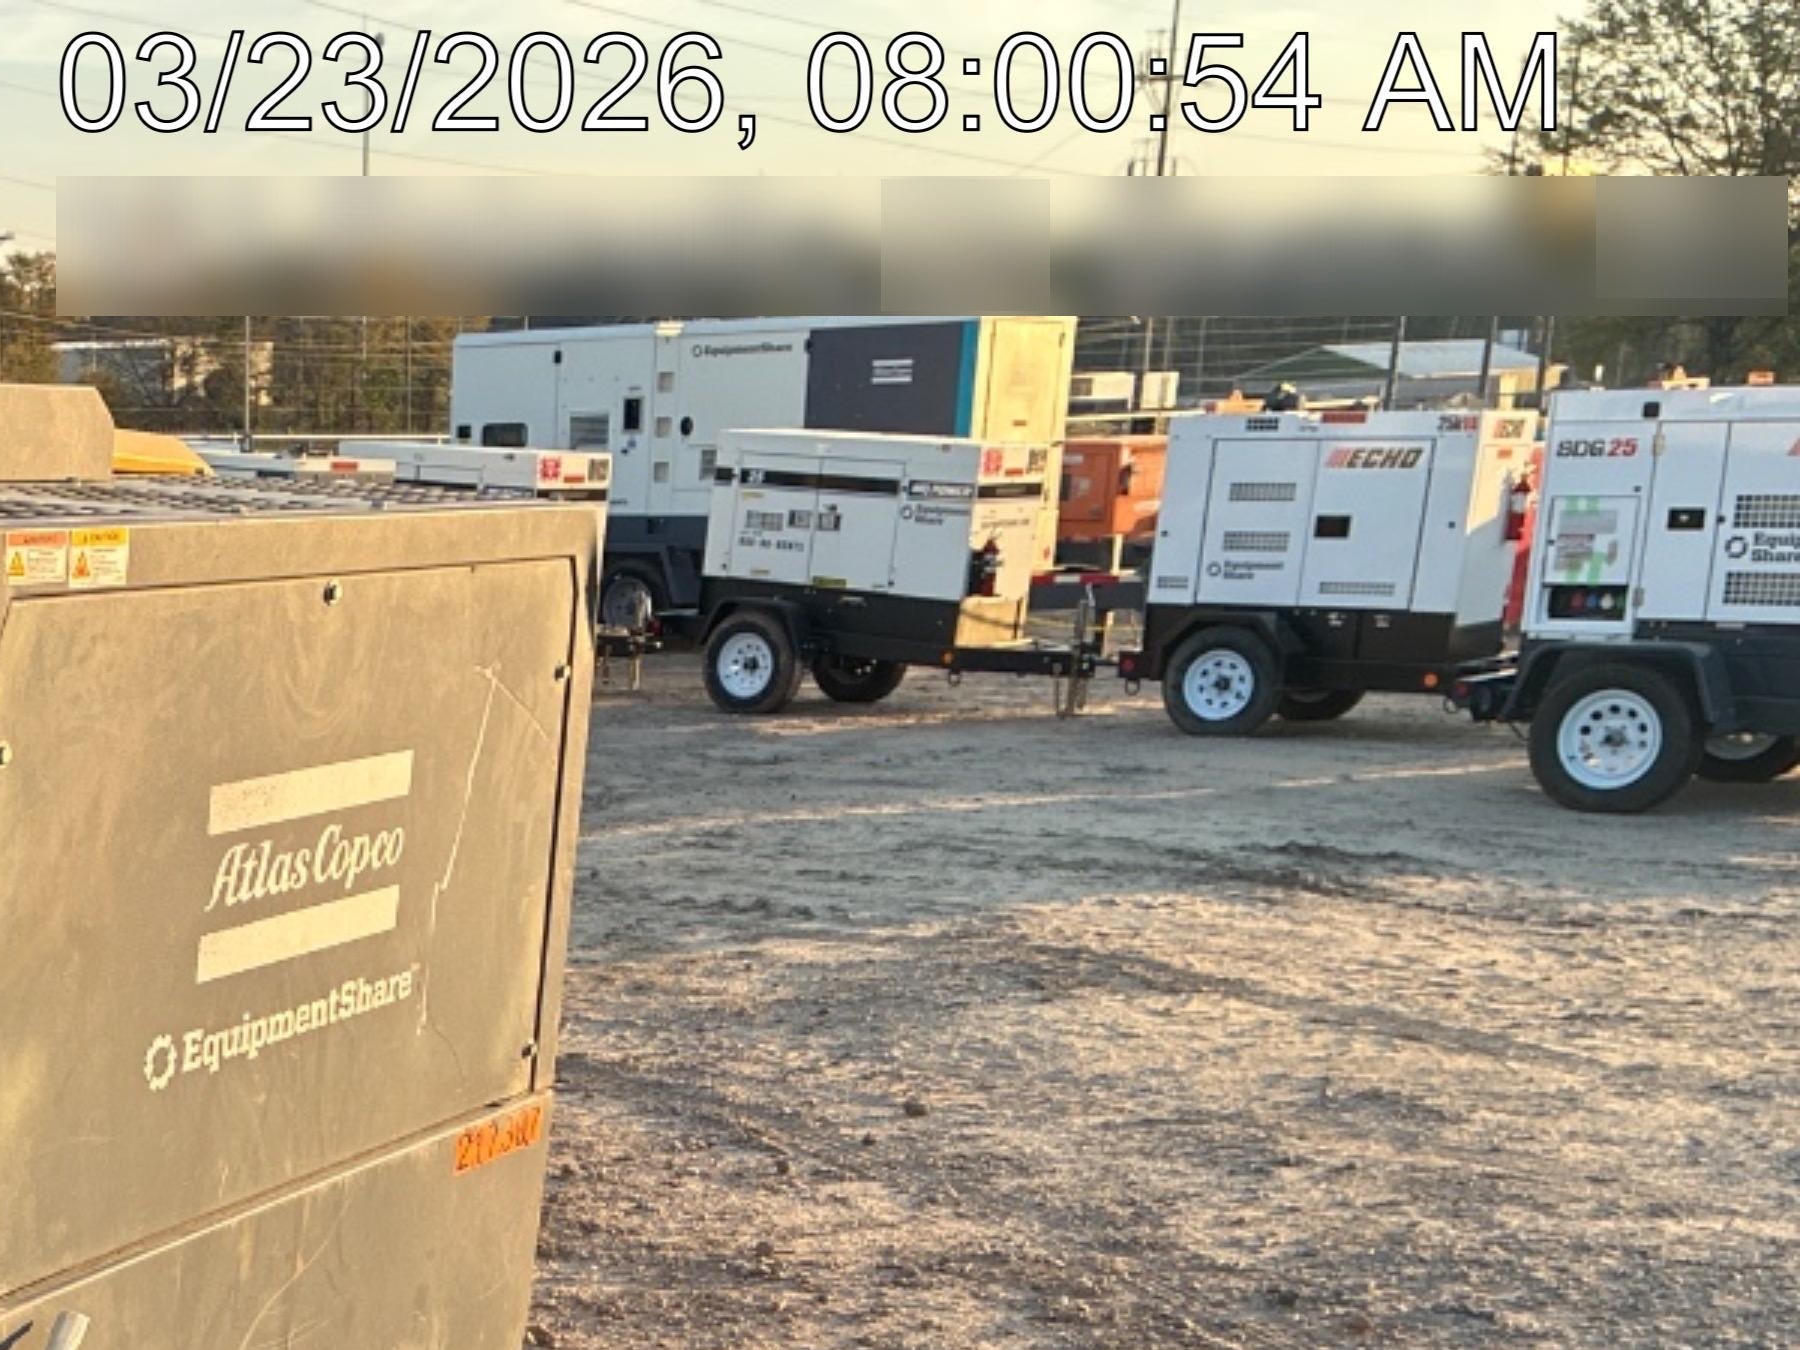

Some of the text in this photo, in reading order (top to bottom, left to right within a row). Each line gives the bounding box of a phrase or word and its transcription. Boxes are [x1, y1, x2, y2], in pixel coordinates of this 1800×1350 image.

[1347, 447, 1425, 469] ECHO
[1556, 437, 1640, 458] SDG 25
[204, 823, 406, 913] Atlas Copco
[181, 967, 413, 1073] EquipmentShare
